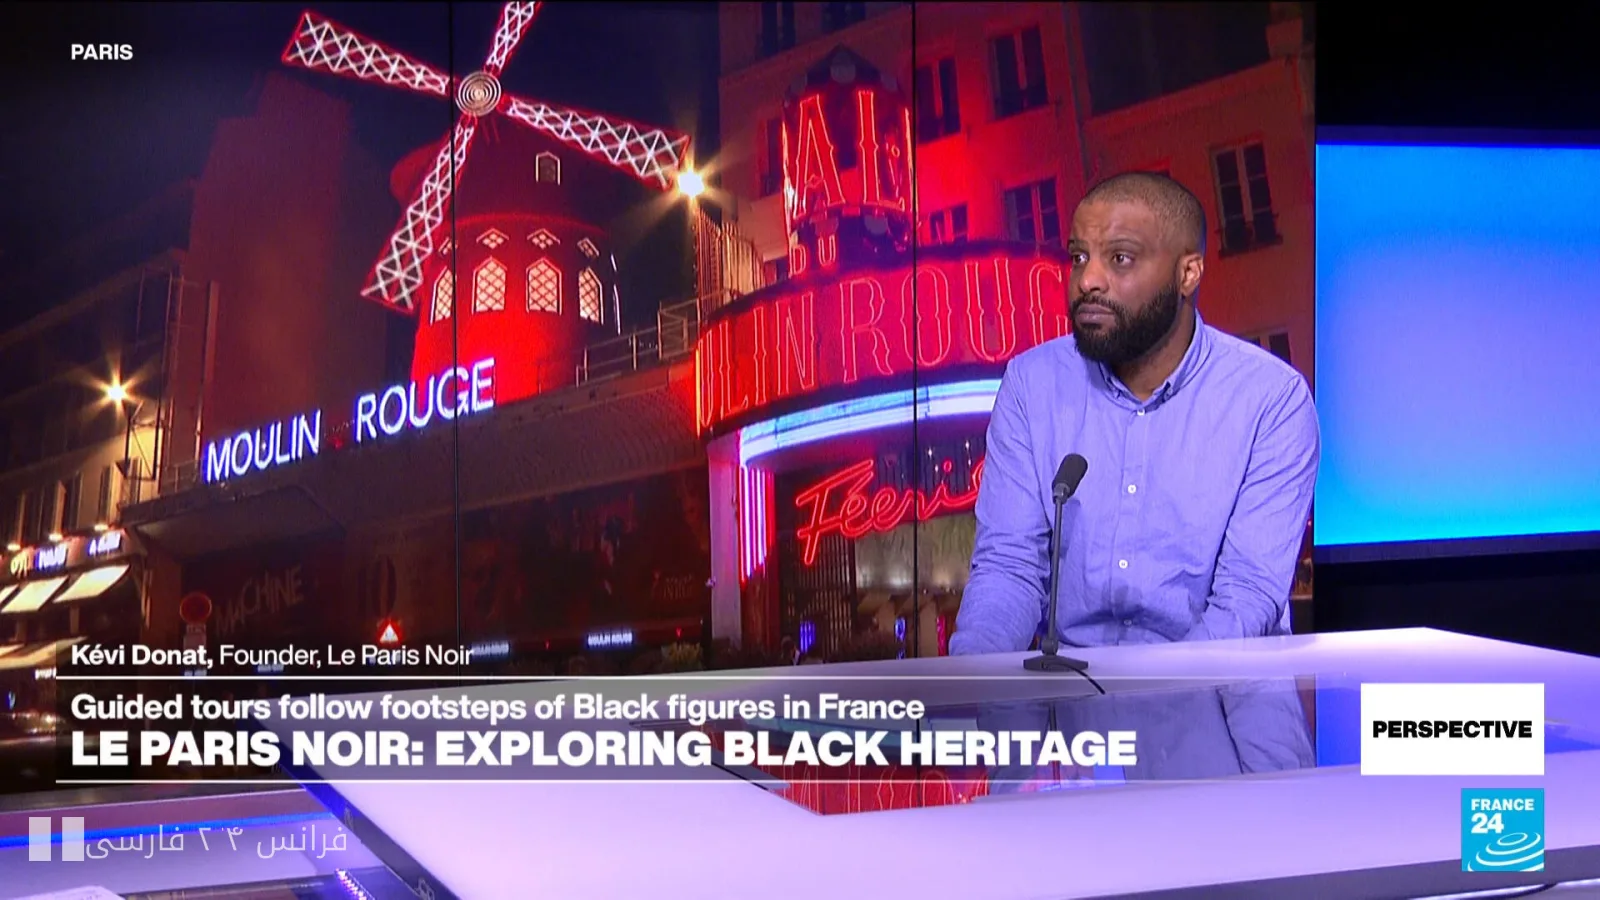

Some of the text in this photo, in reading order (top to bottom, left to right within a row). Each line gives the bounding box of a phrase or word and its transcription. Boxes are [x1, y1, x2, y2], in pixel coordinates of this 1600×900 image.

[783, 90, 906, 220] AL
[788, 234, 837, 278] DU
[839, 257, 1068, 384] ROUG
[204, 356, 496, 484] MOULIN ROUGE
